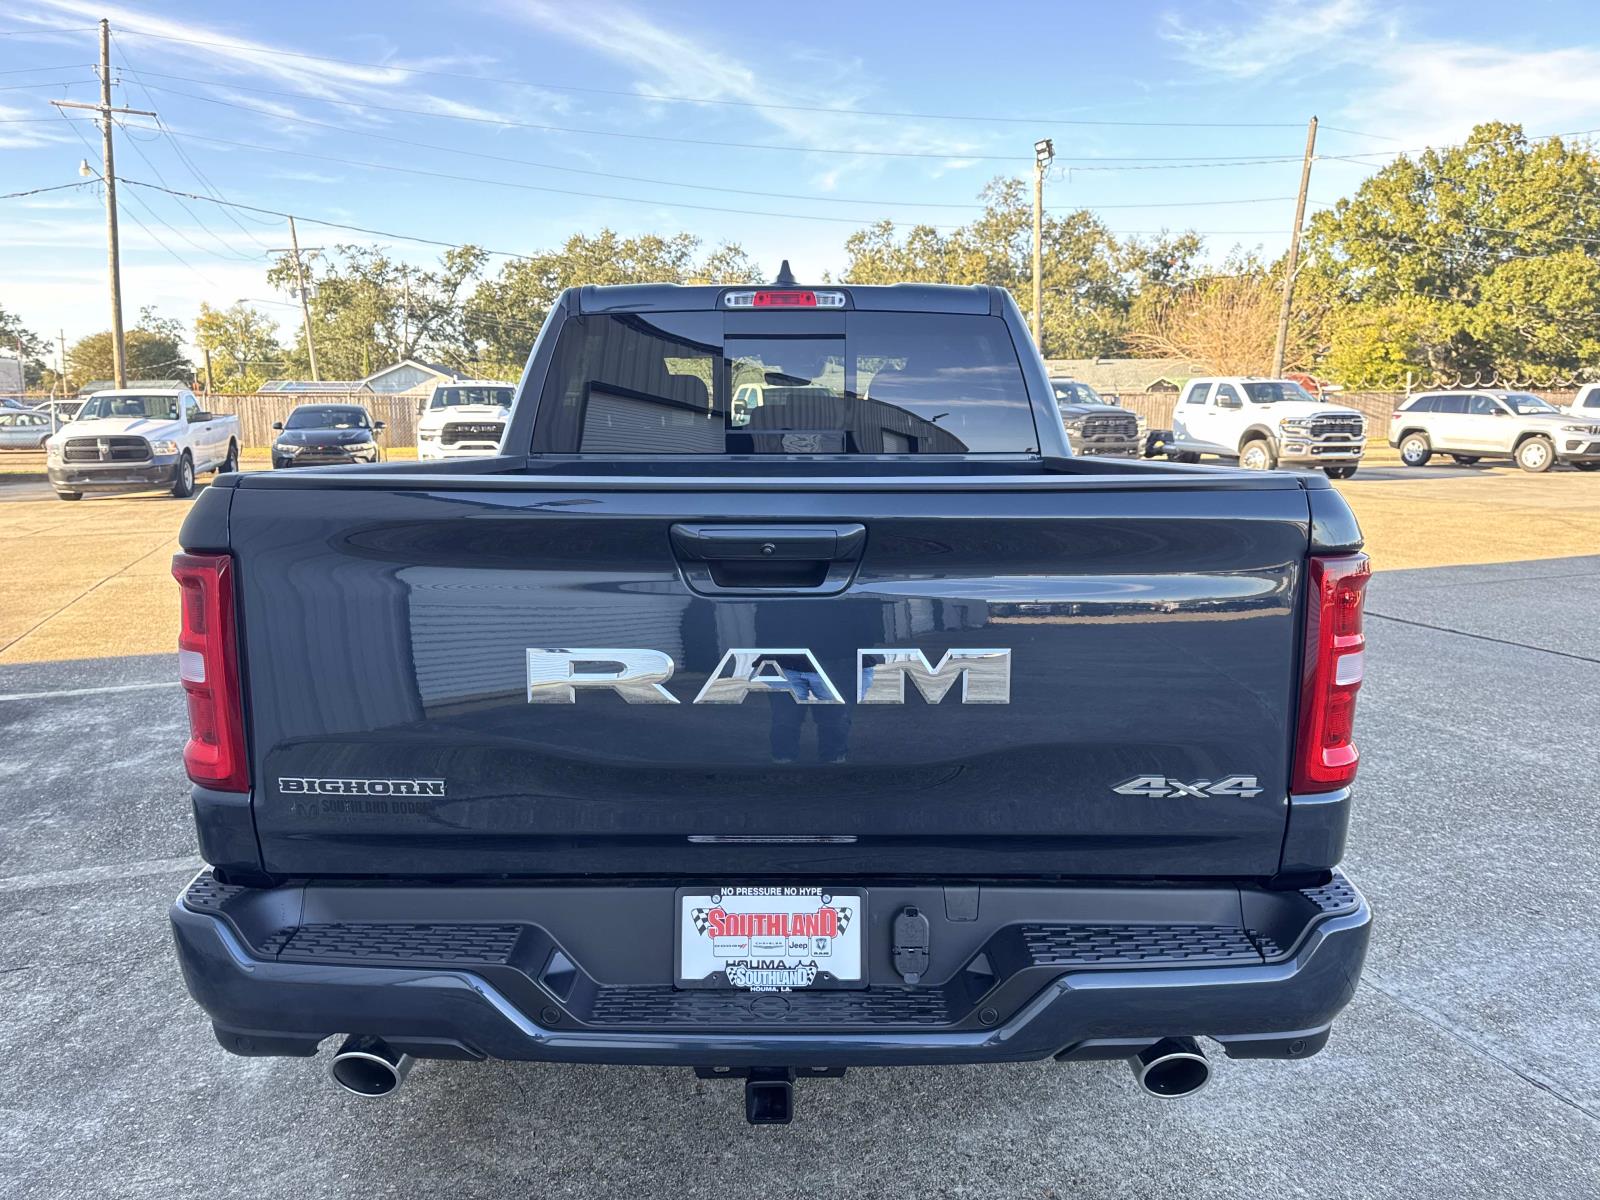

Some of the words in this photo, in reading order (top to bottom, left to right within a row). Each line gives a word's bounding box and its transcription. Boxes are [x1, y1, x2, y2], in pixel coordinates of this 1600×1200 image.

[526, 648, 1011, 704] RAM
[278, 777, 446, 797] BIGHORN
[1111, 774, 1264, 797] 4x4
[321, 799, 388, 814] SOUTHLAND
[721, 887, 734, 896] NO
[736, 887, 782, 896] PRESSURE
[784, 887, 798, 896] NO
[799, 887, 823, 896] HYPE
[708, 907, 838, 938] SOUTHLAND
[789, 941, 808, 951] Jeep
[736, 967, 809, 987] SOUTHLAND
